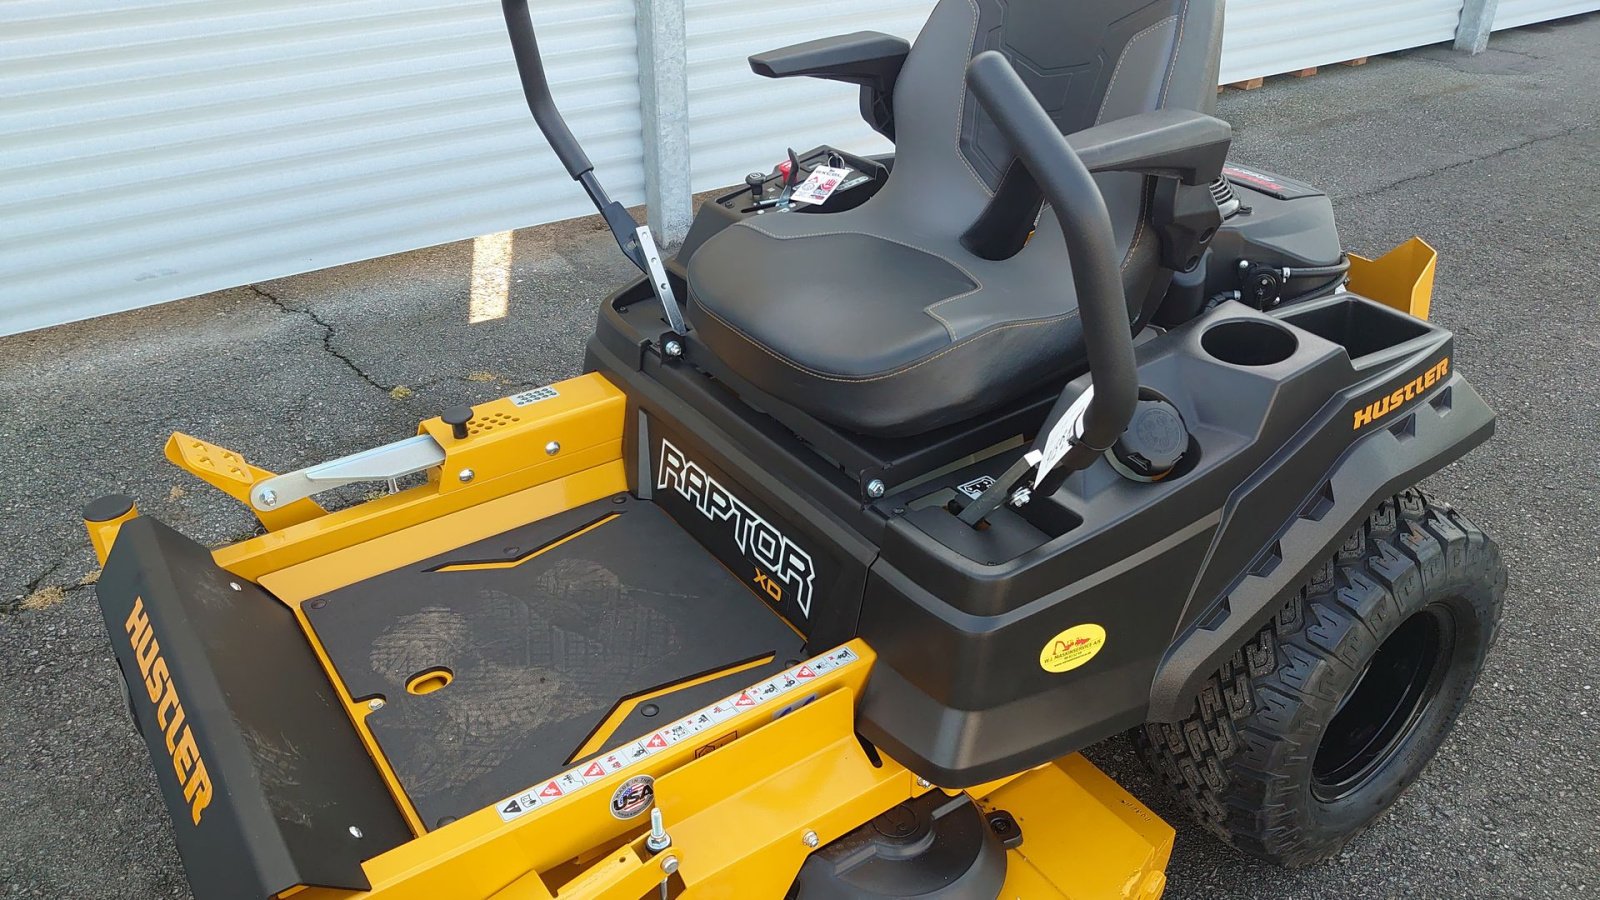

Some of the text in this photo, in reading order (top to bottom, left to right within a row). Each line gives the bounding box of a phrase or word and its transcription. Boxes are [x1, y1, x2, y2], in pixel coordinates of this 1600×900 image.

[1353, 357, 1450, 430] HUSTLER
[657, 437, 816, 620] RAPTOR
[753, 567, 782, 602] XD
[125, 595, 214, 827] HUSTLER
[613, 784, 654, 811] USA
